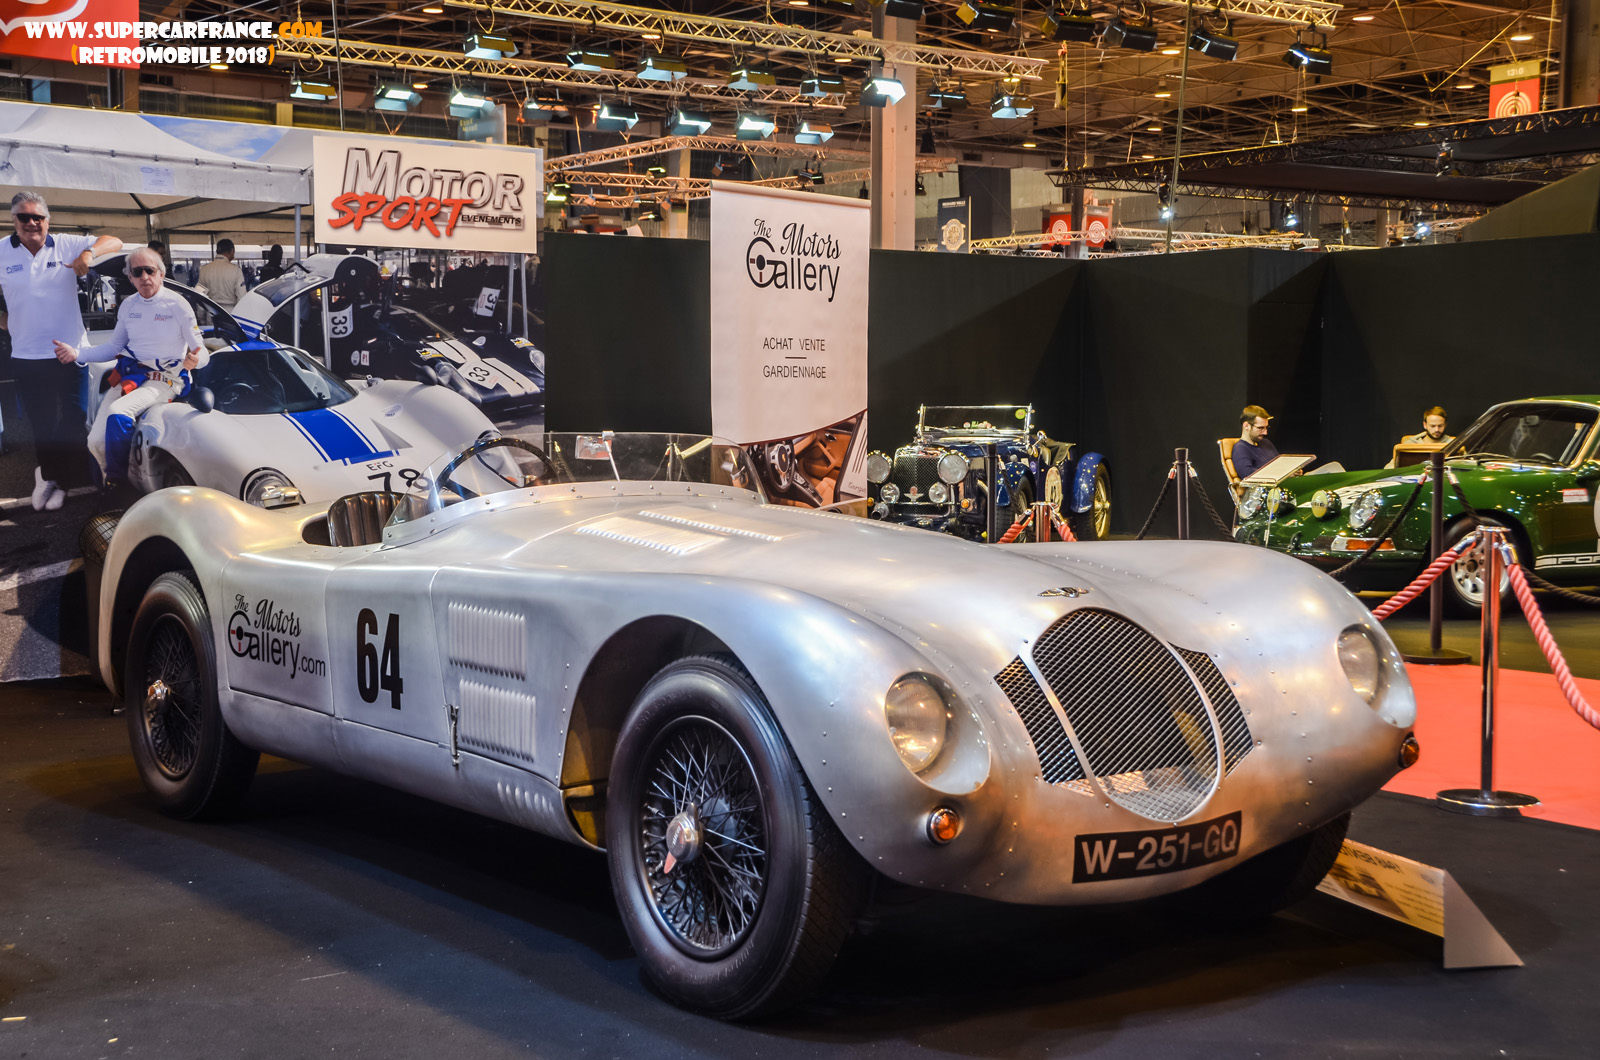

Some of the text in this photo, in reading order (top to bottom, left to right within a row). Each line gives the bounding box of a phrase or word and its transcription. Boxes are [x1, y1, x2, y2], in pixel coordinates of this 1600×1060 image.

[341, 147, 524, 211] MOTOR
[328, 192, 474, 237] SPORT
[461, 214, 522, 225] EVENEMENTS
[753, 218, 842, 260] The Motors
[746, 237, 840, 303] Gallery
[331, 316, 348, 335] 33
[763, 337, 826, 351] ACHAT VENTE
[468, 366, 491, 382] 33
[763, 365, 827, 379] GARDIENNAGE
[366, 460, 394, 471] EFG
[367, 468, 432, 492] 78
[234, 593, 301, 637] The Motors
[356, 607, 403, 711] 64
[1081, 819, 1238, 875] W-251-GQ
